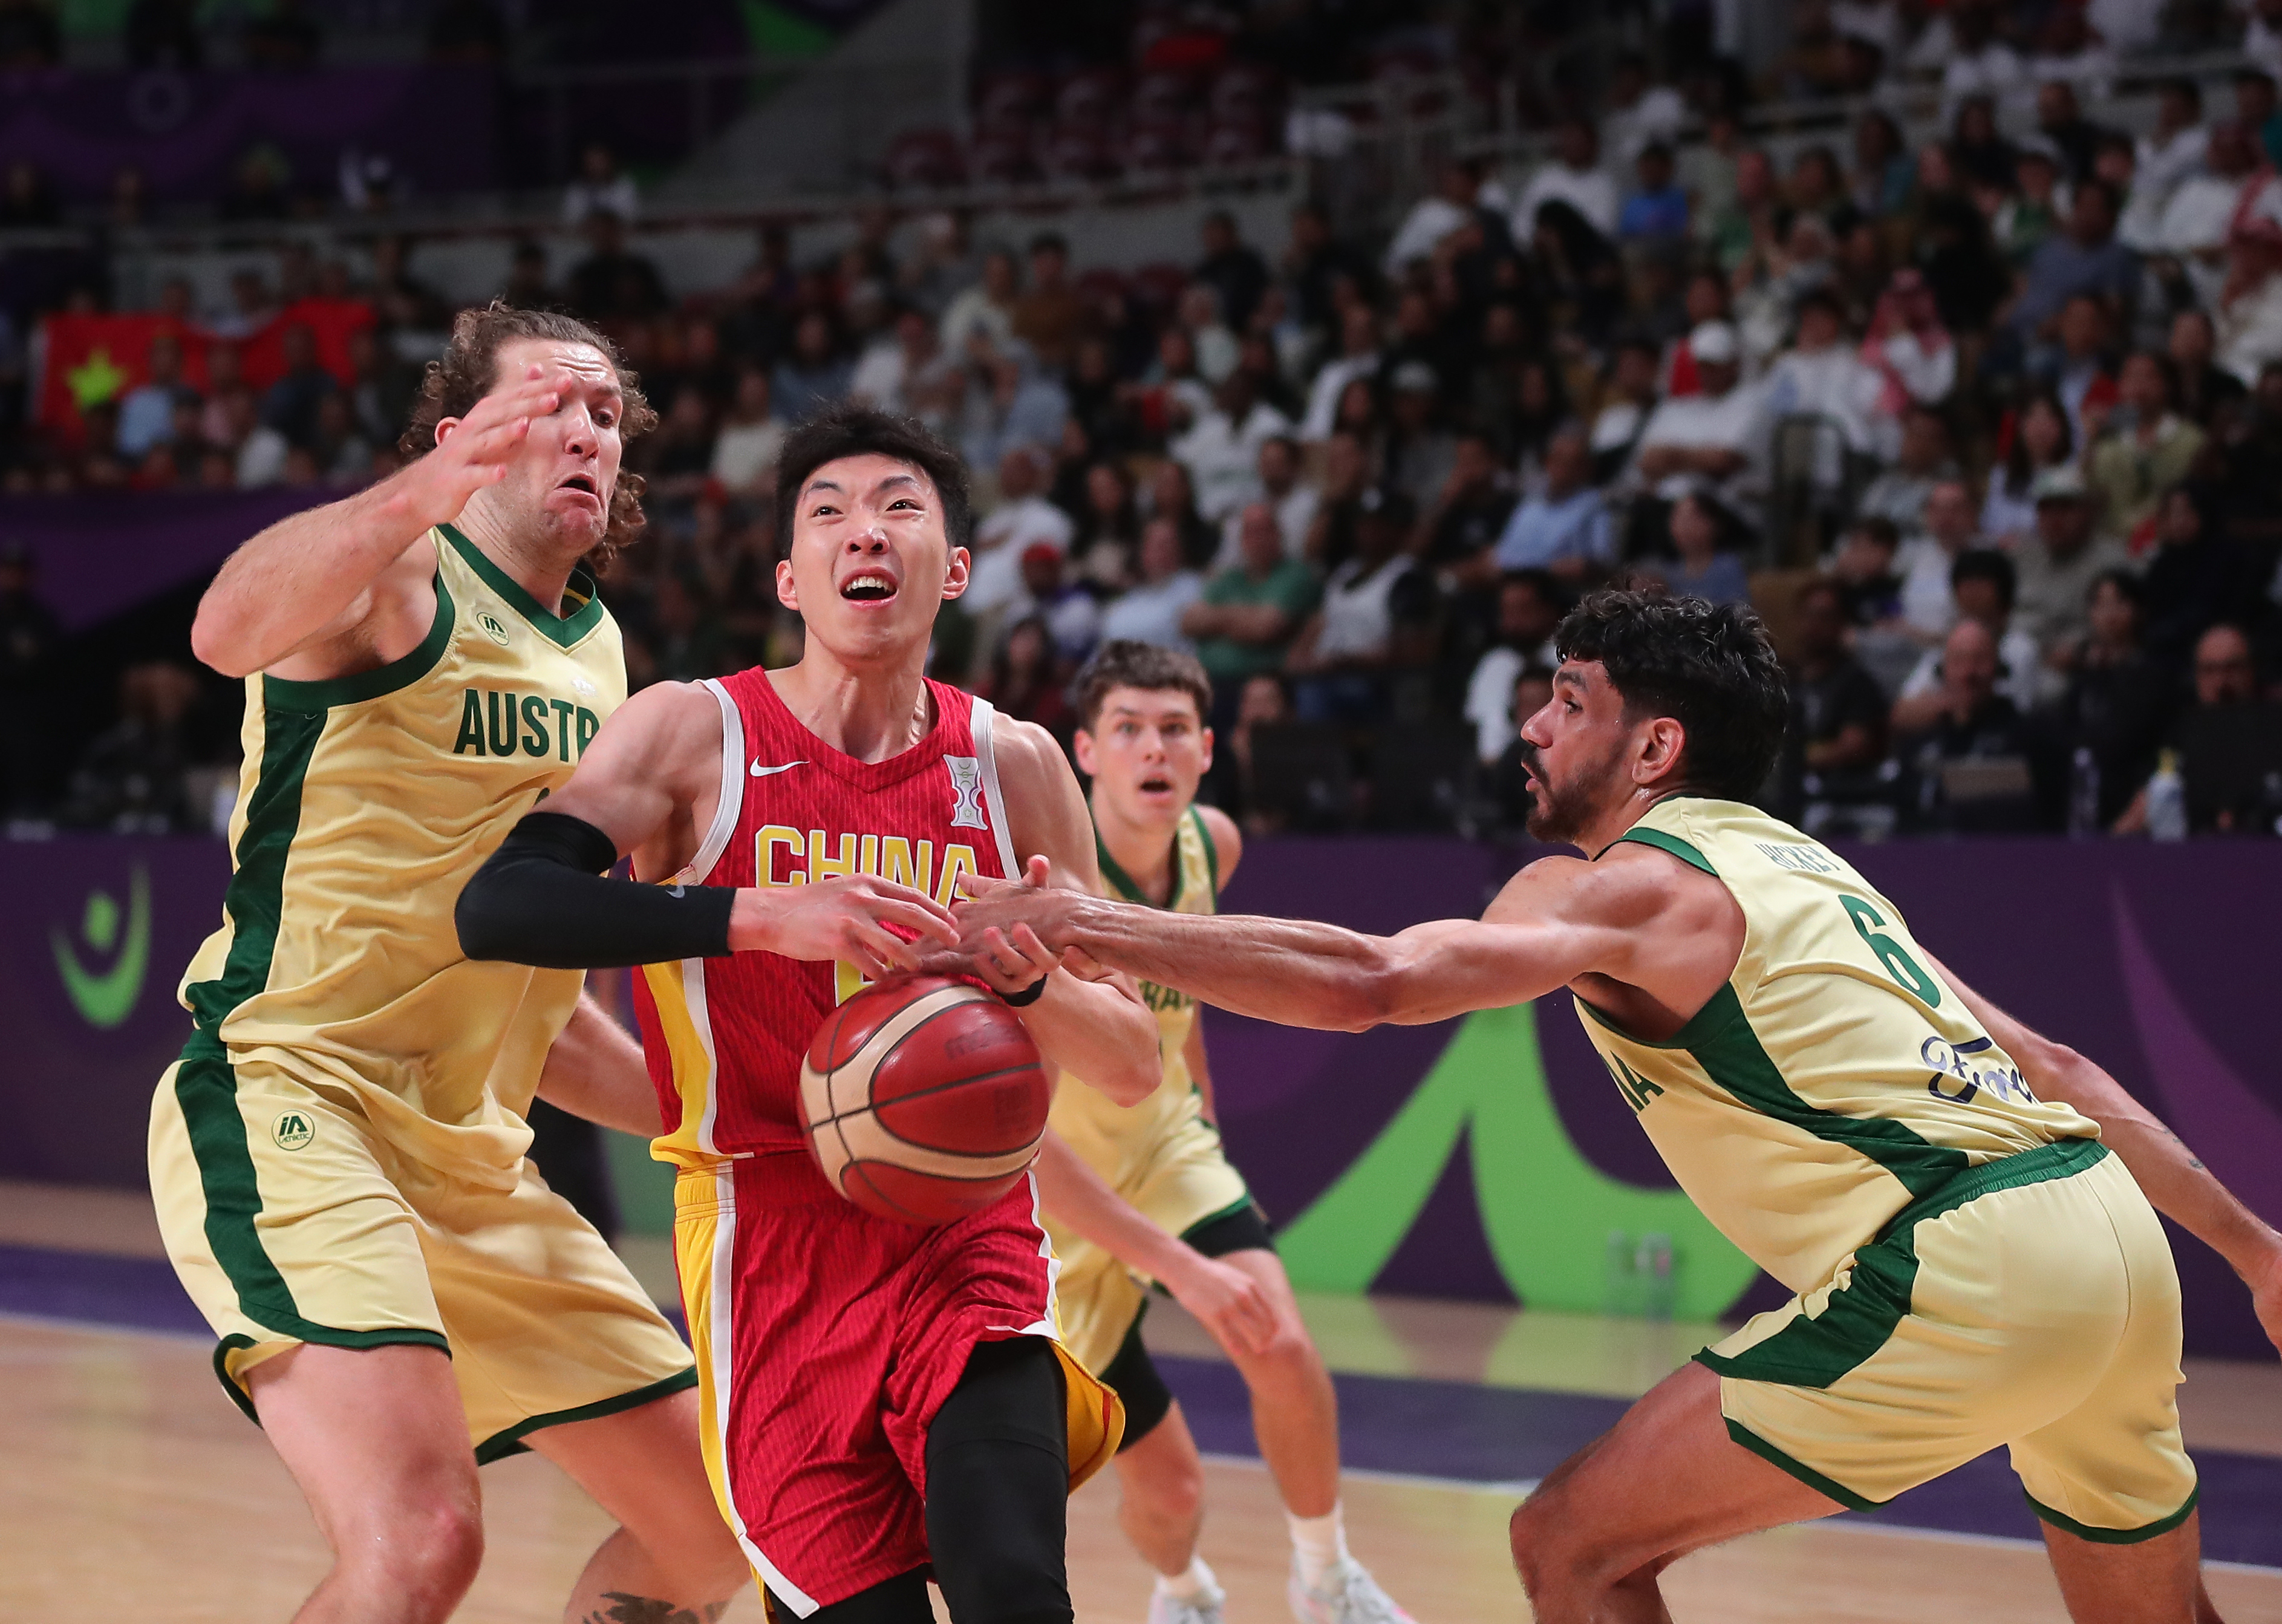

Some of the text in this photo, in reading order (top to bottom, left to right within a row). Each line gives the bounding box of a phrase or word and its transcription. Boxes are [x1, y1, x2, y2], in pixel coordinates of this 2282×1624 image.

[755, 824, 980, 909] CHINA
[1754, 844, 1840, 872] HICKEY
[1837, 894, 1941, 1008] 6
